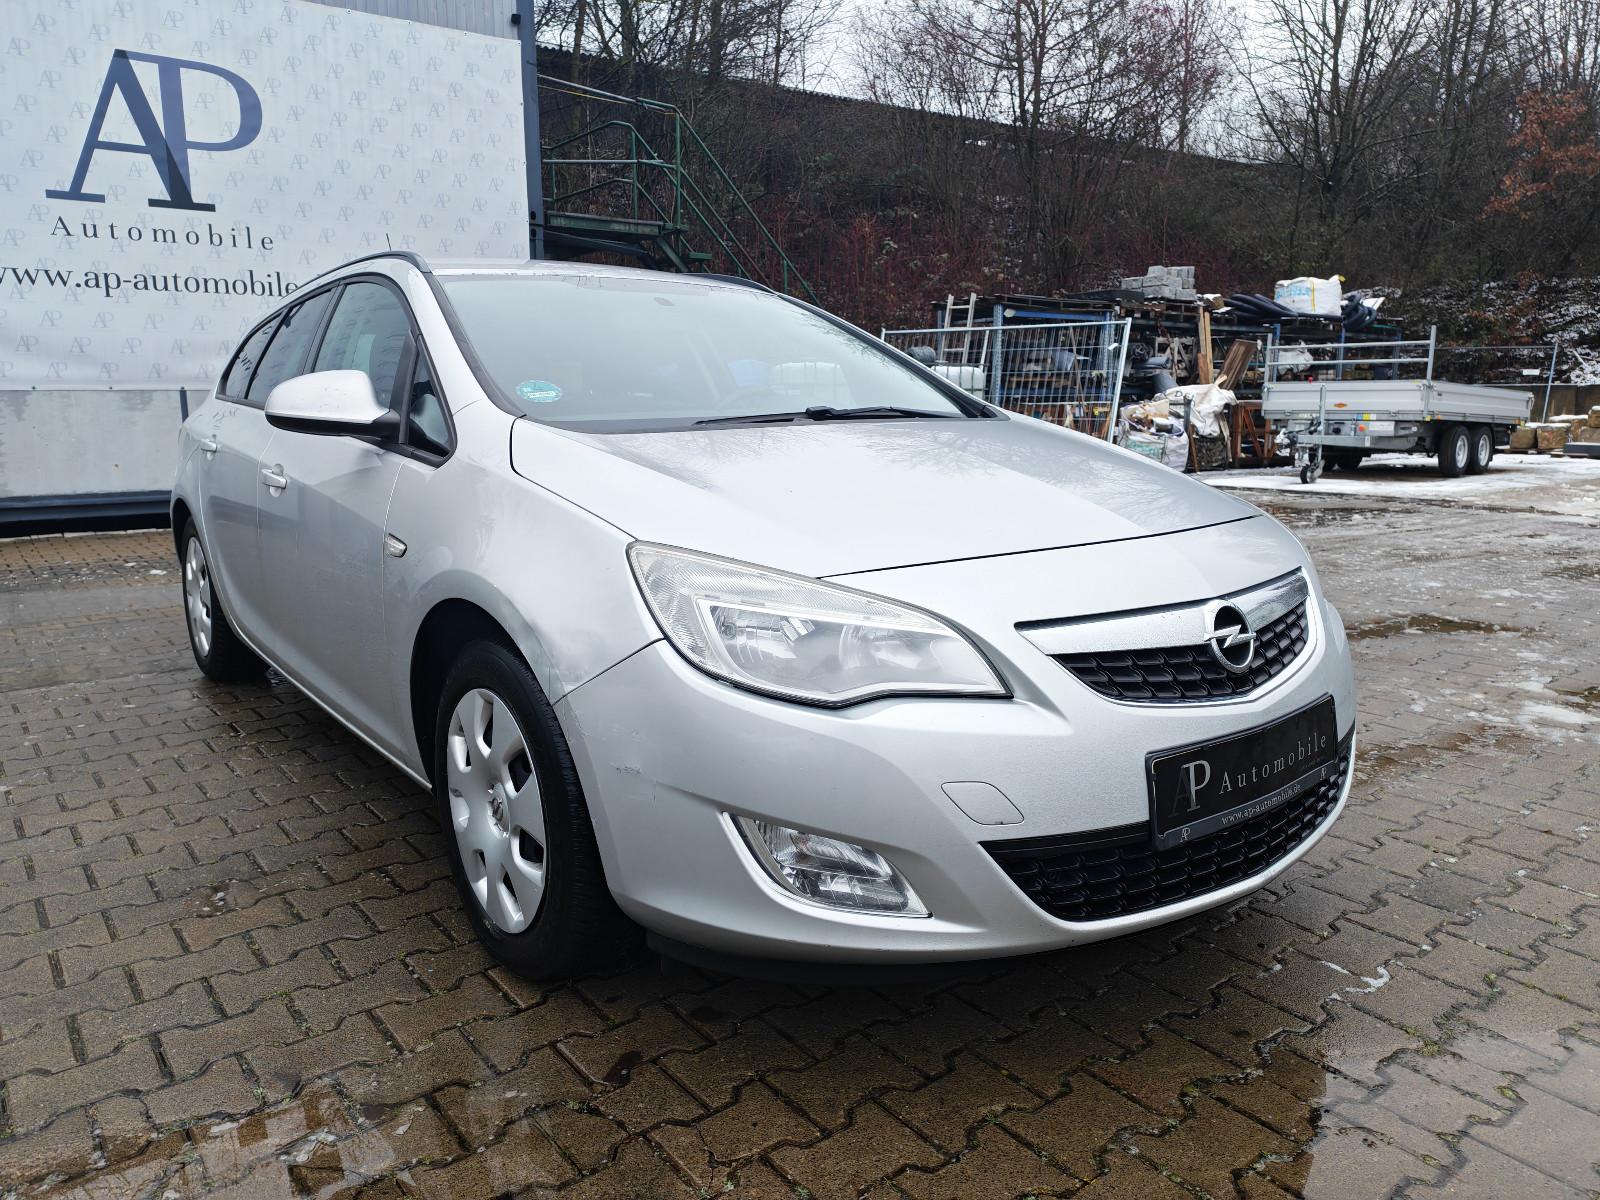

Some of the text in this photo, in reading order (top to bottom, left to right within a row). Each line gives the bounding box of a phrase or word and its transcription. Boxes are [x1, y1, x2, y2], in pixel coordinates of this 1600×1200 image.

[45, 48, 262, 212] AP
[51, 216, 274, 251] Automobile
[1219, 733, 1327, 795] Automobile
[1221, 784, 1302, 825] www.ap-automobile.de
